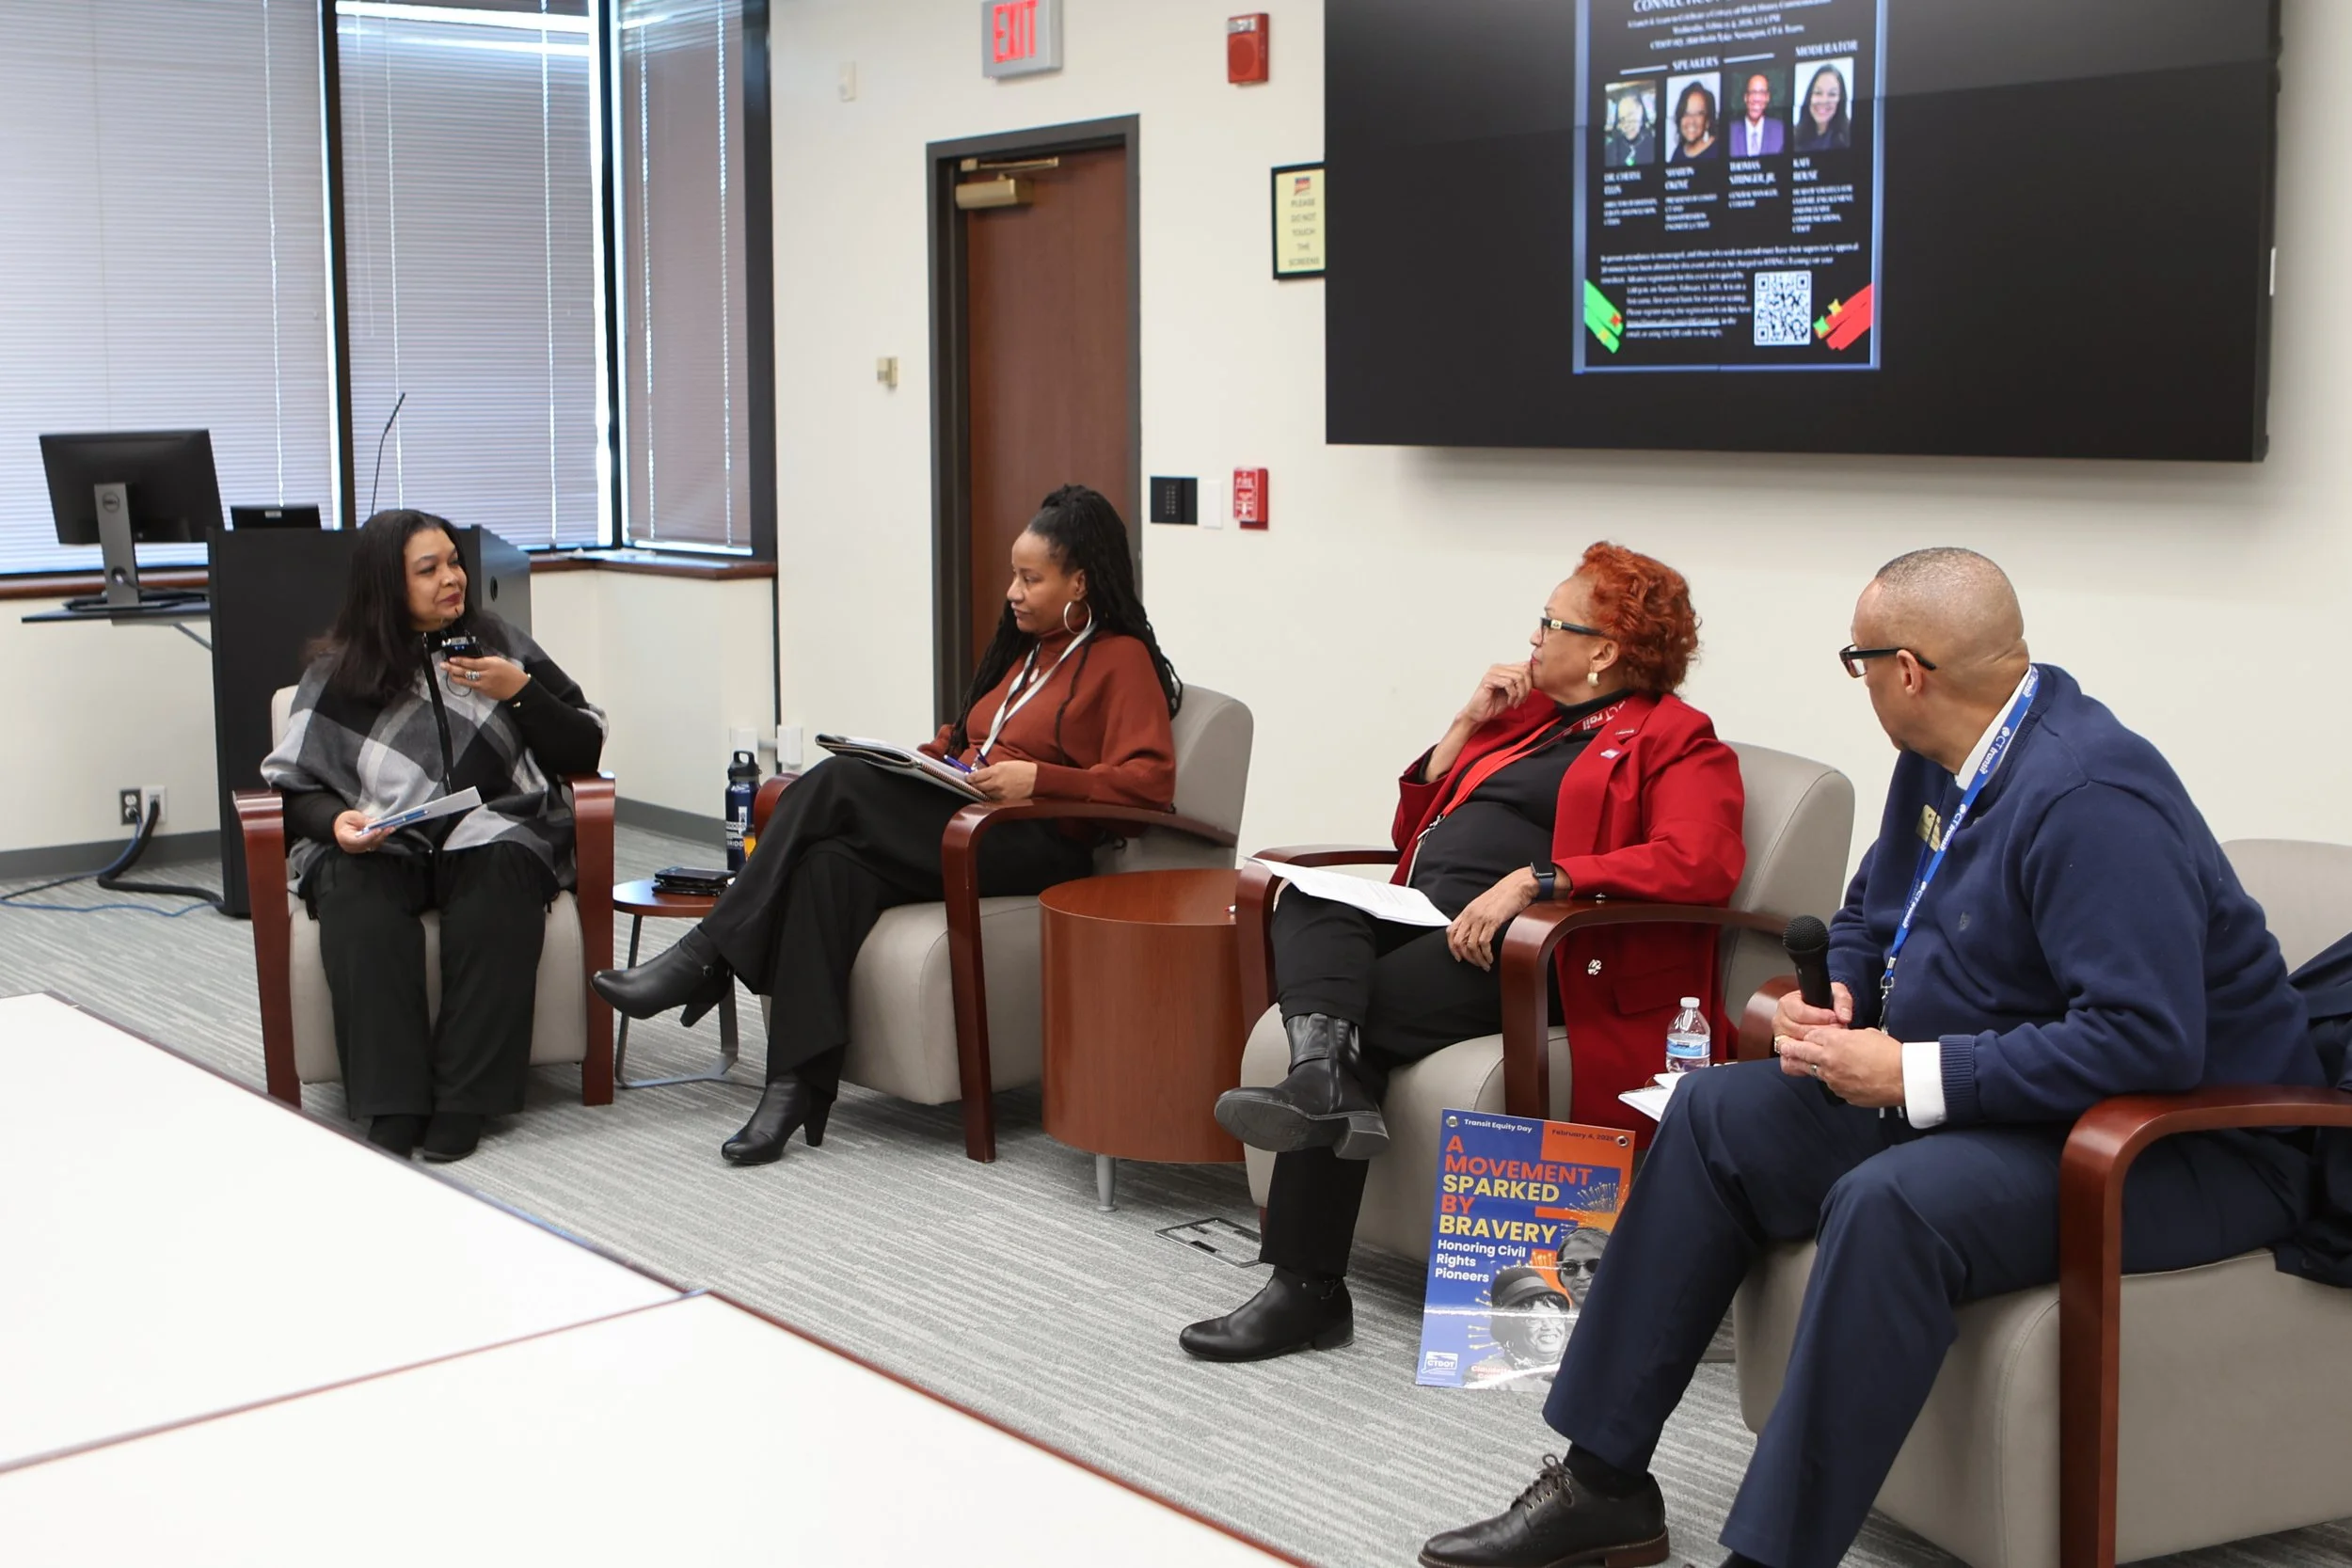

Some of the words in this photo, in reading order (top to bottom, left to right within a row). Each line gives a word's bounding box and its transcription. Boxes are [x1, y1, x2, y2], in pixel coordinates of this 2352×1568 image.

[993, 0, 1039, 64] EXIT
[1795, 40, 1858, 56] MODERATOR
[1672, 55, 1720, 71] SPEAKERS
[1291, 198, 1315, 207] PLEASE
[1465, 1118, 1491, 1129] Transit
[1492, 1121, 1517, 1132] Equity
[1517, 1123, 1533, 1133] Day
[1446, 1134, 1464, 1153] A
[1552, 1130, 1587, 1140] February
[1444, 1154, 1593, 1186] MOVEMENT
[1442, 1174, 1560, 1202] SPARKED
[1440, 1194, 1475, 1214] BY
[1438, 1214, 1558, 1244] BRAVERY
[1438, 1239, 1496, 1258] Honoring
[1498, 1244, 1526, 1258] Civil
[1436, 1253, 1476, 1268] Rights
[1435, 1267, 1489, 1283] Pioneers
